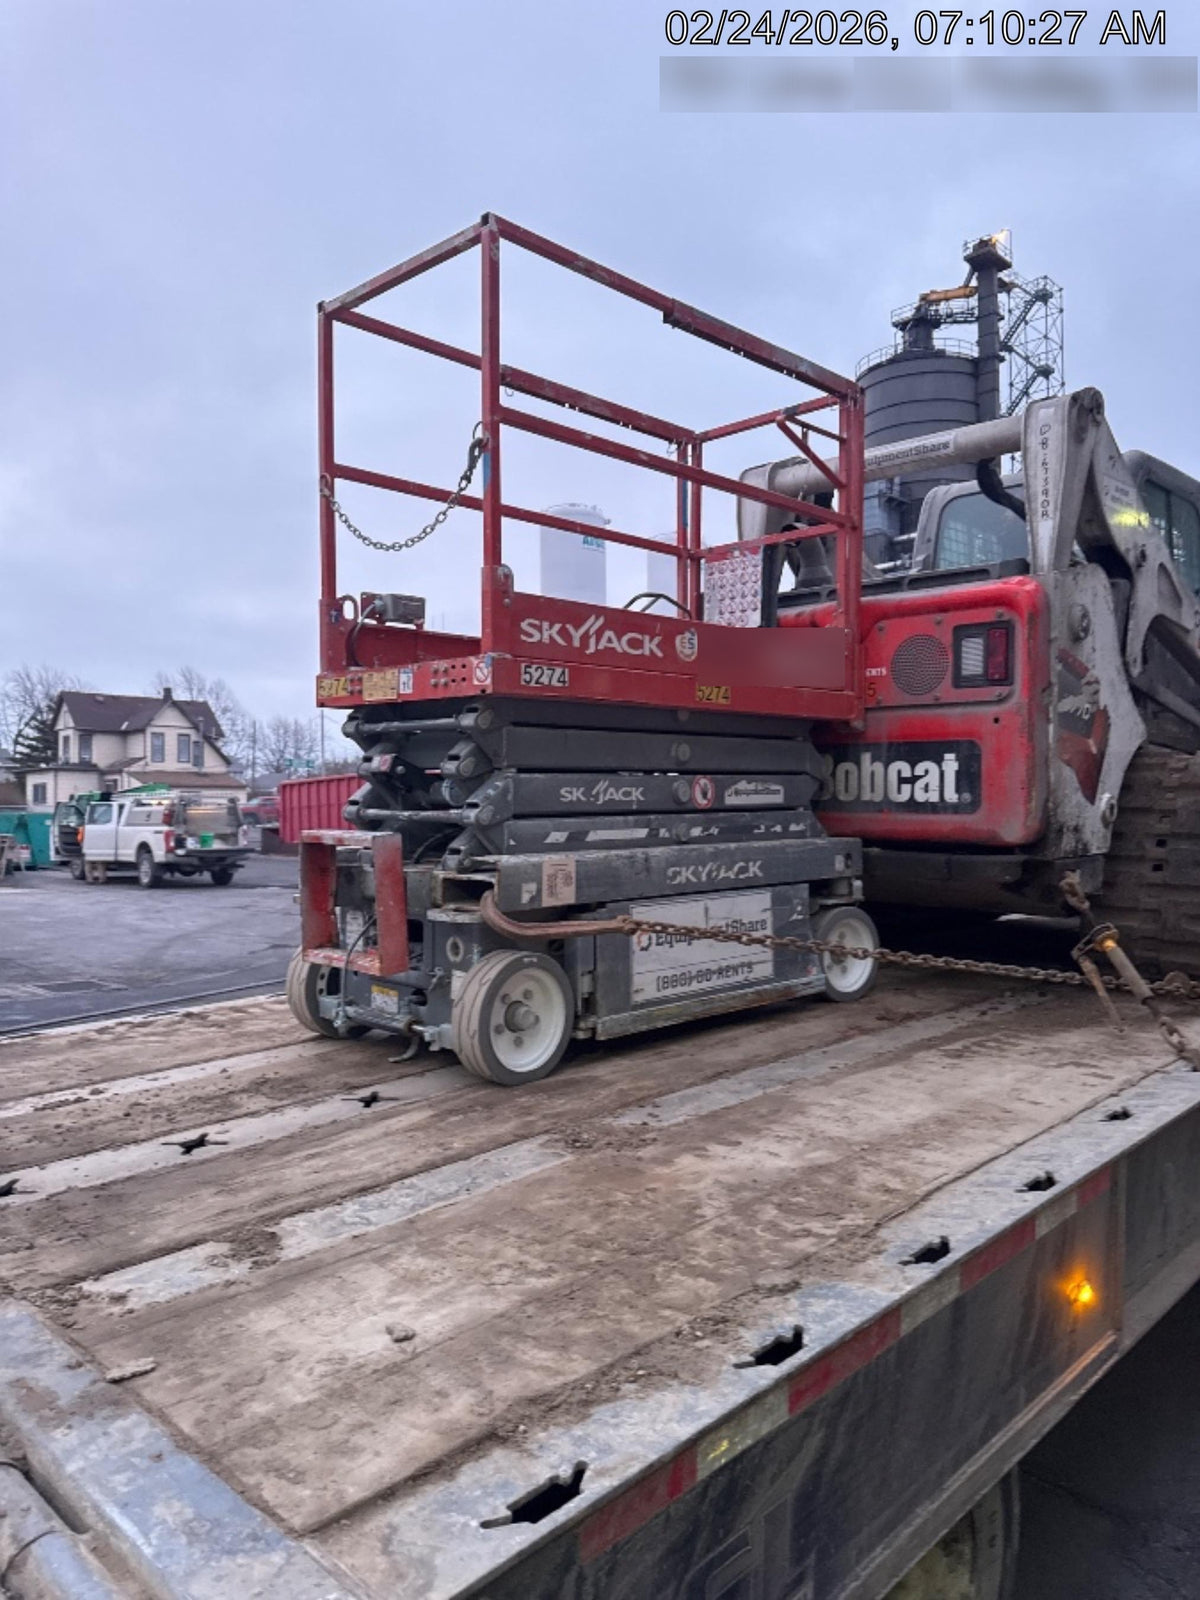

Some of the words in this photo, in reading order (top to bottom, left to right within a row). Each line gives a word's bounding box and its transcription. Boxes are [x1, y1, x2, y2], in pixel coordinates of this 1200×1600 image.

[520, 615, 664, 657] SKYJACK
[522, 664, 568, 686] 5274
[697, 686, 730, 702] 5274
[655, 918, 769, 948] EquiptShare
